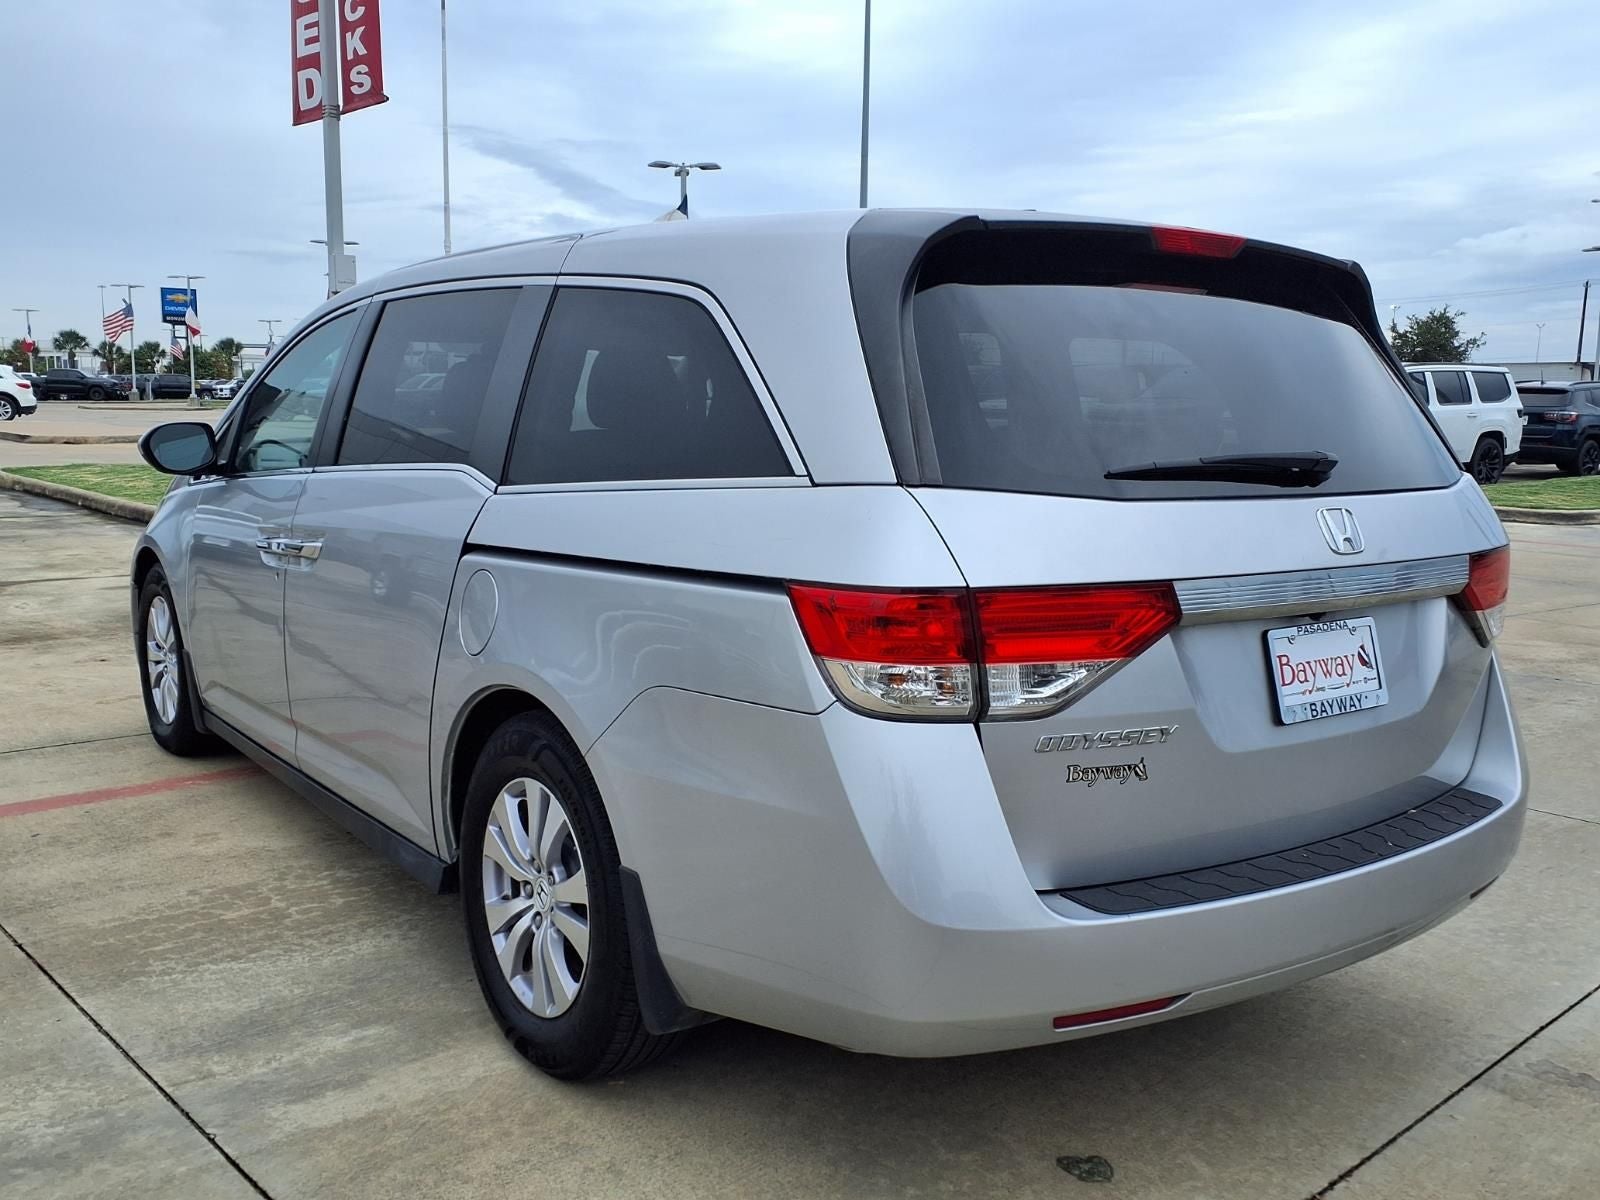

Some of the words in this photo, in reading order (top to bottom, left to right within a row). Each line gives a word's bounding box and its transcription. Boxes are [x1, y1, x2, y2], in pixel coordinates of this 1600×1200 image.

[295, 0, 322, 111] ED
[344, 0, 372, 95] CKS
[1296, 620, 1349, 635] PASADENA
[1276, 653, 1356, 695] Bayway
[1309, 694, 1363, 718] BAYWAY
[1034, 724, 1180, 753] ODYSSEY
[1066, 763, 1138, 787] Bayway
